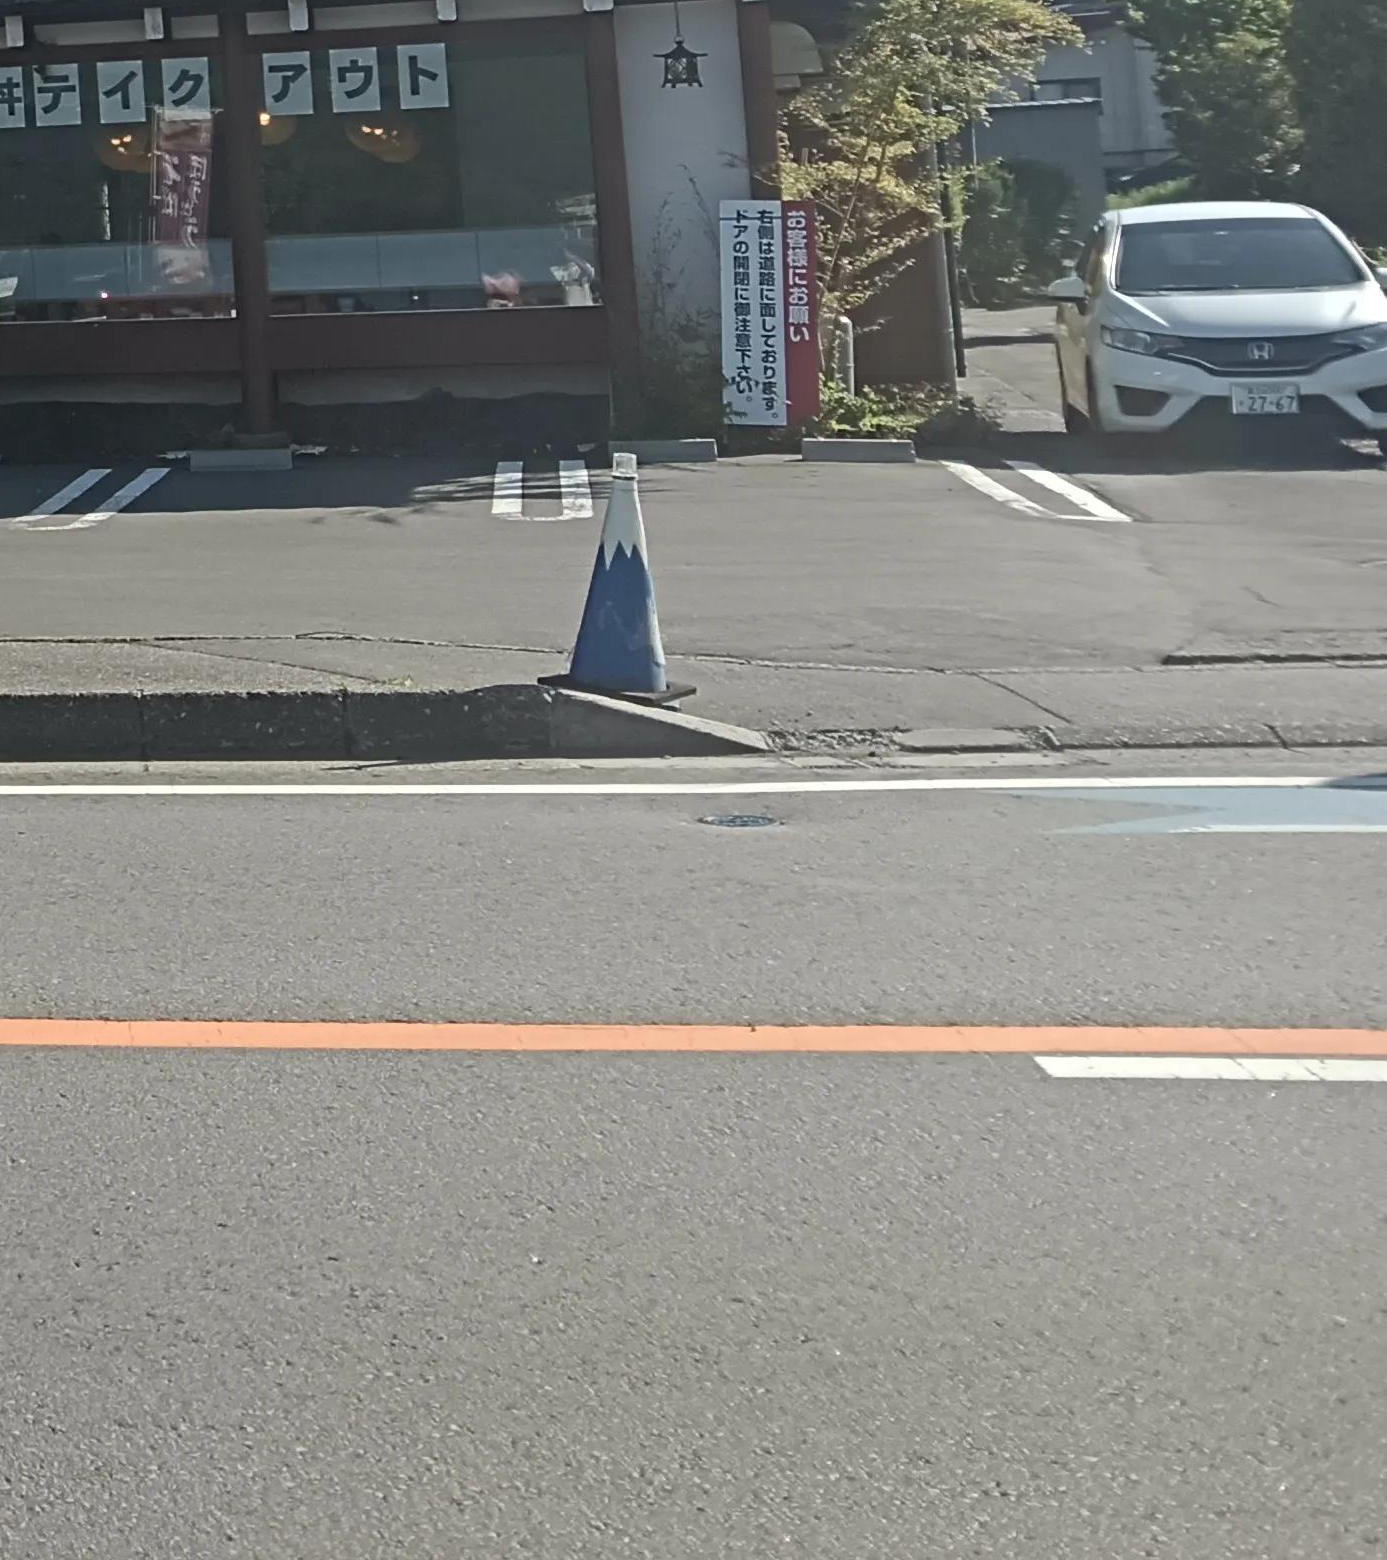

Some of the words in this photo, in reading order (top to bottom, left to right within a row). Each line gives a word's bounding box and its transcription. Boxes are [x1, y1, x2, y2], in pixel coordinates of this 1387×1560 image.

[757, 209, 779, 418] 右側は道路に面しております。
[787, 210, 810, 342] お客様にお願い
